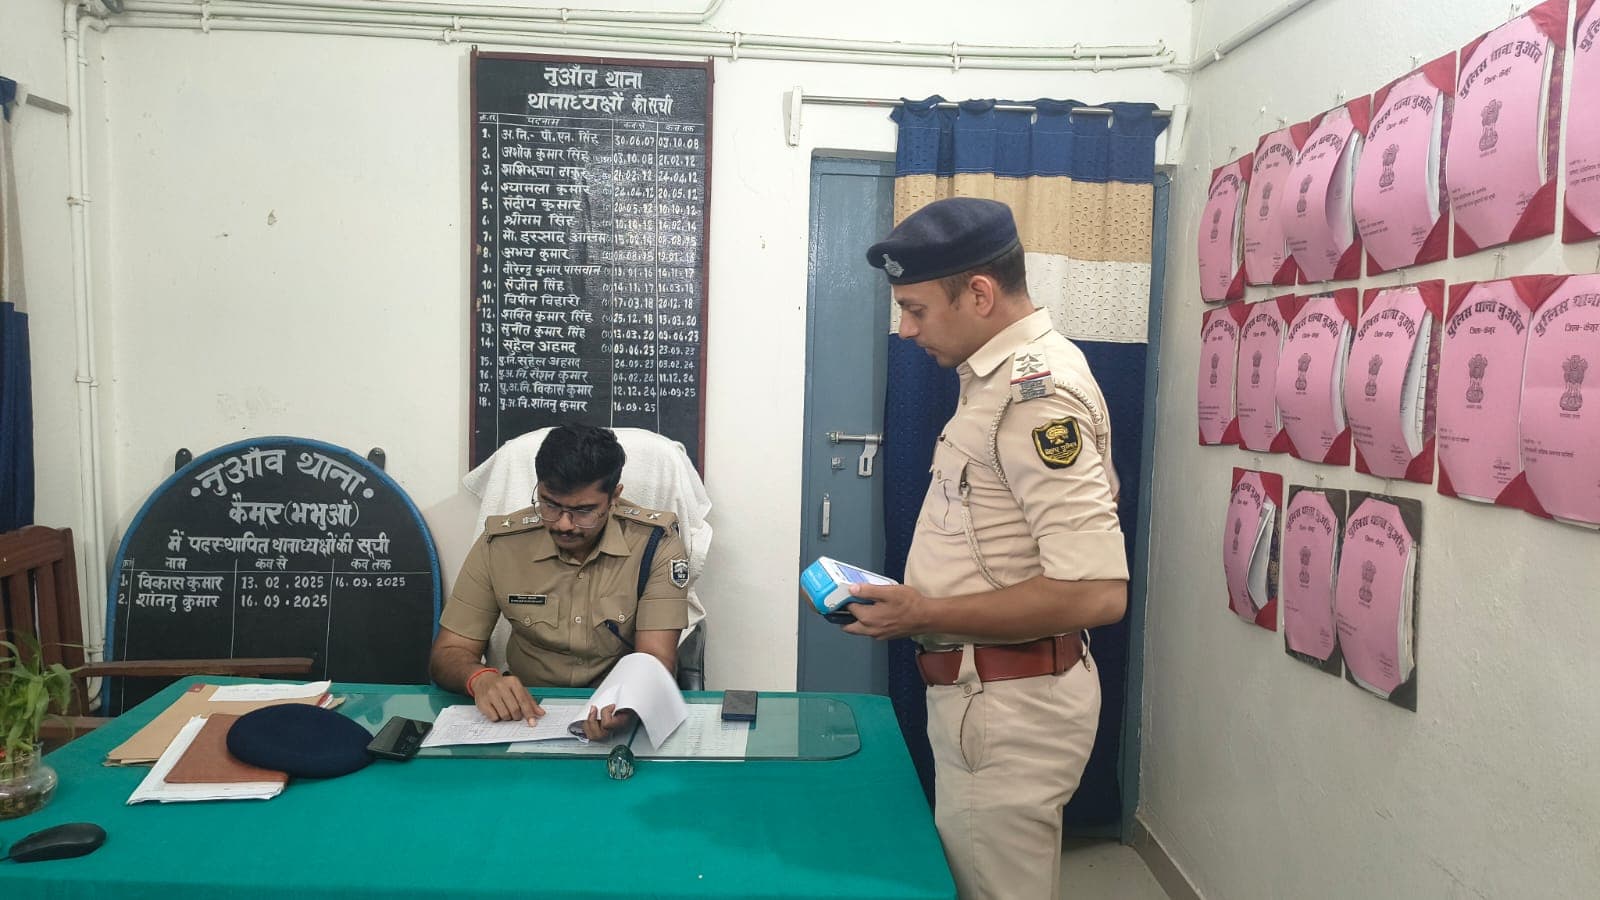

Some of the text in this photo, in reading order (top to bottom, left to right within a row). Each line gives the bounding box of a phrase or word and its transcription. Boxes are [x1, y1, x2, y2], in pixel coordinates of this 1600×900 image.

[606, 71, 642, 89] थाना
[527, 92, 624, 114] थानाध्यक्षों
[632, 94, 647, 114] की
[527, 117, 560, 126] पदनाम
[502, 144, 532, 160] अशोक
[536, 148, 563, 161] कुमार
[556, 184, 592, 196] कुमार
[502, 194, 536, 212] संदीप
[540, 199, 582, 212] कुमार
[504, 212, 542, 226] श्रीराम
[540, 248, 570, 261] कुमार
[536, 265, 562, 276] कुमार
[563, 265, 602, 276] पासवान
[504, 276, 538, 292] संजीत
[544, 278, 565, 292] सिंह
[500, 308, 532, 320] शक्ति
[534, 311, 567, 322] कुमार
[570, 310, 594, 323] सिंह
[1534, 298, 1570, 338] पुलिस
[500, 322, 531, 336] सुनीत
[534, 326, 564, 338] कुमार
[568, 325, 586, 339] सिंह
[537, 341, 576, 354] अहमद
[614, 344, 654, 356] 09.06.23
[549, 356, 580, 368] अहमद
[558, 371, 588, 382] कुमार
[532, 381, 566, 396] विकास
[566, 384, 594, 398] कुमार
[531, 397, 558, 413] शांतनु
[560, 400, 588, 412] कुमार
[296, 452, 366, 496] थाना
[168, 529, 390, 560] में पदस्थापित थानाध्यक्षों की सूची
[165, 556, 188, 570] नाम
[276, 556, 288, 571] से
[371, 558, 392, 570] तक
[138, 572, 186, 590] विकास
[186, 576, 224, 592] कुमार
[136, 590, 178, 612] शांतनु
[182, 594, 220, 612] कुमार
